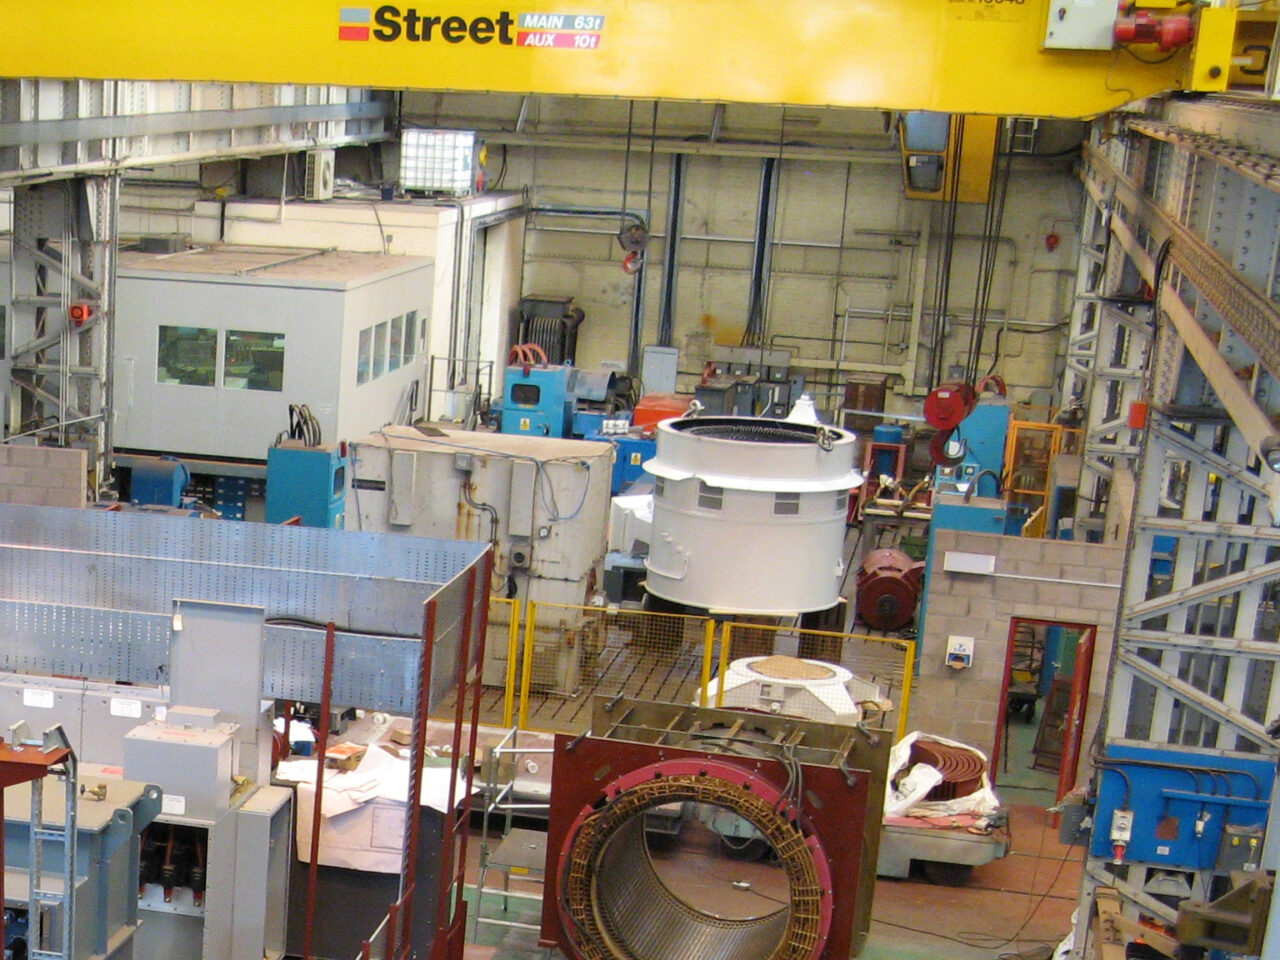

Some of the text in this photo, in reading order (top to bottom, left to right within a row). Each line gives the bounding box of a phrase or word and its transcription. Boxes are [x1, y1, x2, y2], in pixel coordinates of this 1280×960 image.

[373, 5, 514, 45] Street
[524, 15, 600, 30] MAIN 63t
[524, 34, 596, 48] AUX 10t
